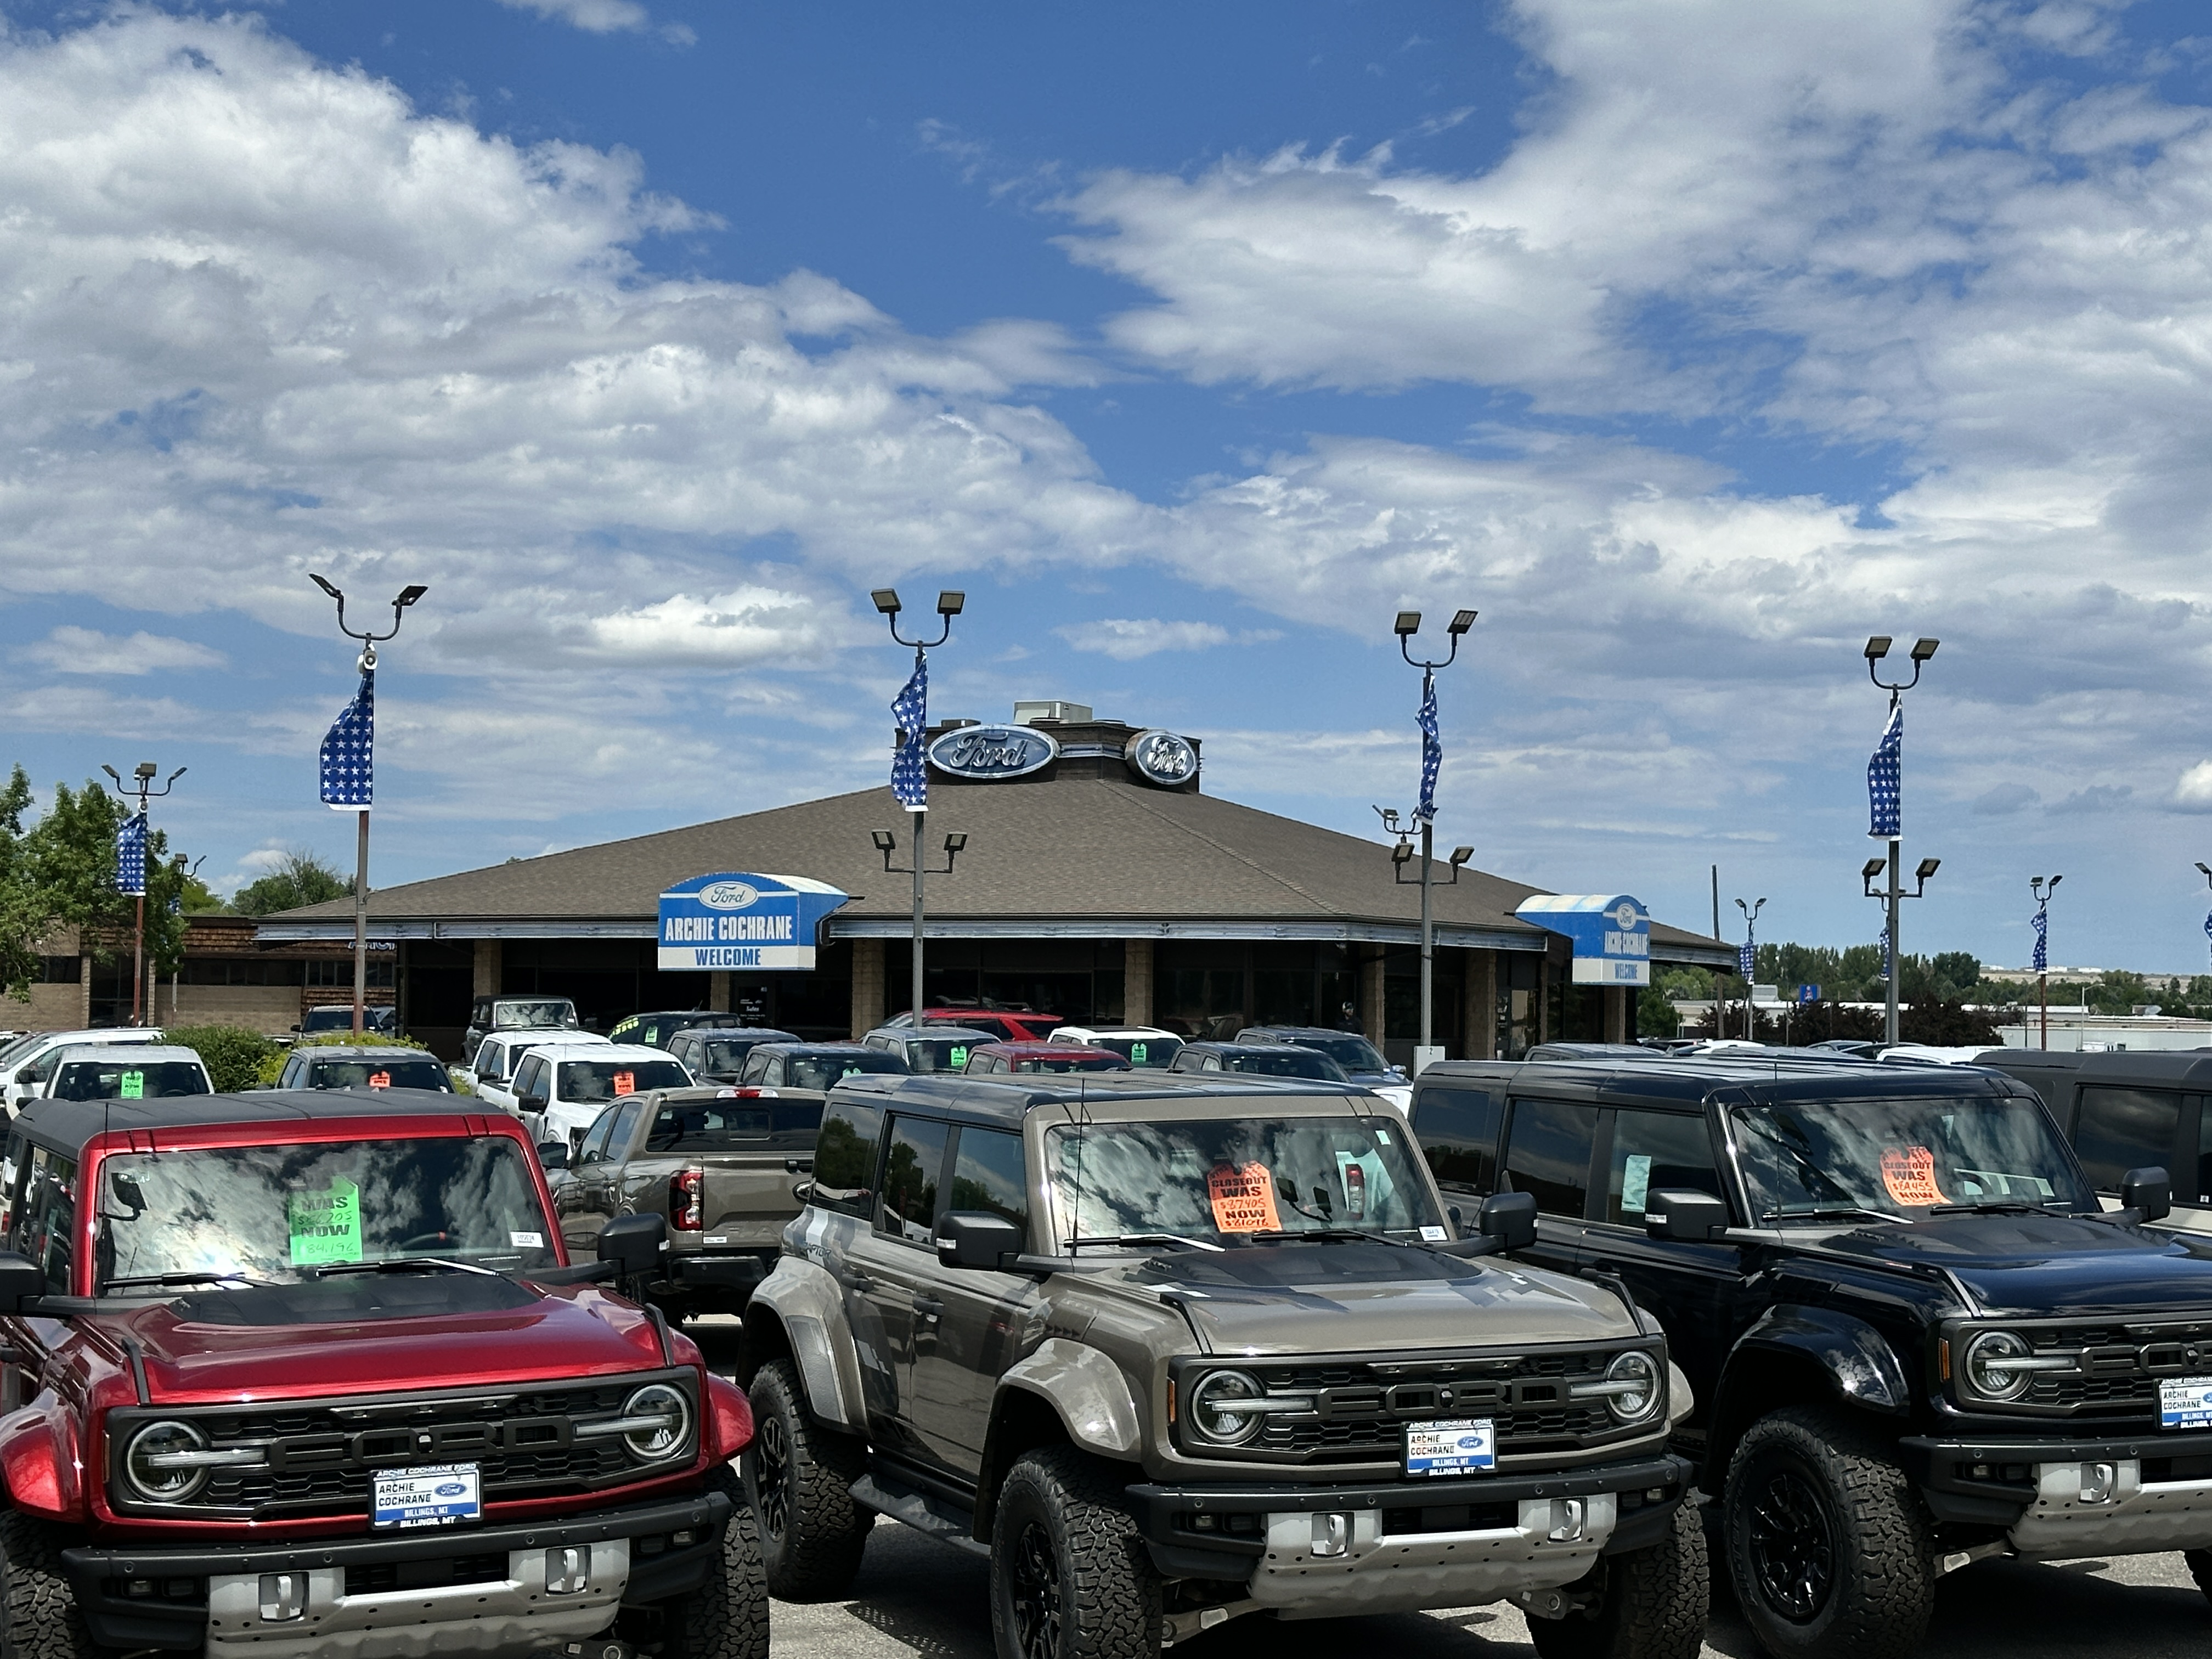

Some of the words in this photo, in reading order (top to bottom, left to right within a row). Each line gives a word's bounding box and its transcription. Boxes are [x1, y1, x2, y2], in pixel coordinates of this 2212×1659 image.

[950, 732, 1028, 767] Ford
[1147, 737, 1188, 775] Ford
[711, 886, 744, 903] Ford
[1620, 908, 1632, 924] Ford
[665, 917, 714, 941] ARCHIE
[719, 916, 792, 940] COCHRANE
[695, 949, 761, 966] WELCOME
[1615, 963, 1637, 979] WELCOME
[1211, 1176, 1267, 1188] CLOSEOUT
[1892, 1171, 1926, 1181] WAS
[1221, 1186, 1262, 1198] WAS
[301, 1197, 348, 1211] WAS
[1225, 1210, 1266, 1218] NOW
[301, 1224, 350, 1238] NOW
[1319, 1376, 1568, 1421] FORD
[2163, 1390, 2188, 1399] ARCHIE
[2164, 1400, 2201, 1410] COCHRANE
[269, 1415, 572, 1474] FORD
[1411, 1434, 1440, 1444] ARCHIE
[377, 1469, 407, 1477] ARCHIE
[408, 1465, 453, 1474] COCHRANE
[379, 1482, 415, 1494] ARCHIE
[441, 1485, 460, 1494] Ford
[379, 1494, 431, 1506] COCHRANE
[442, 1516, 456, 1524] MT
